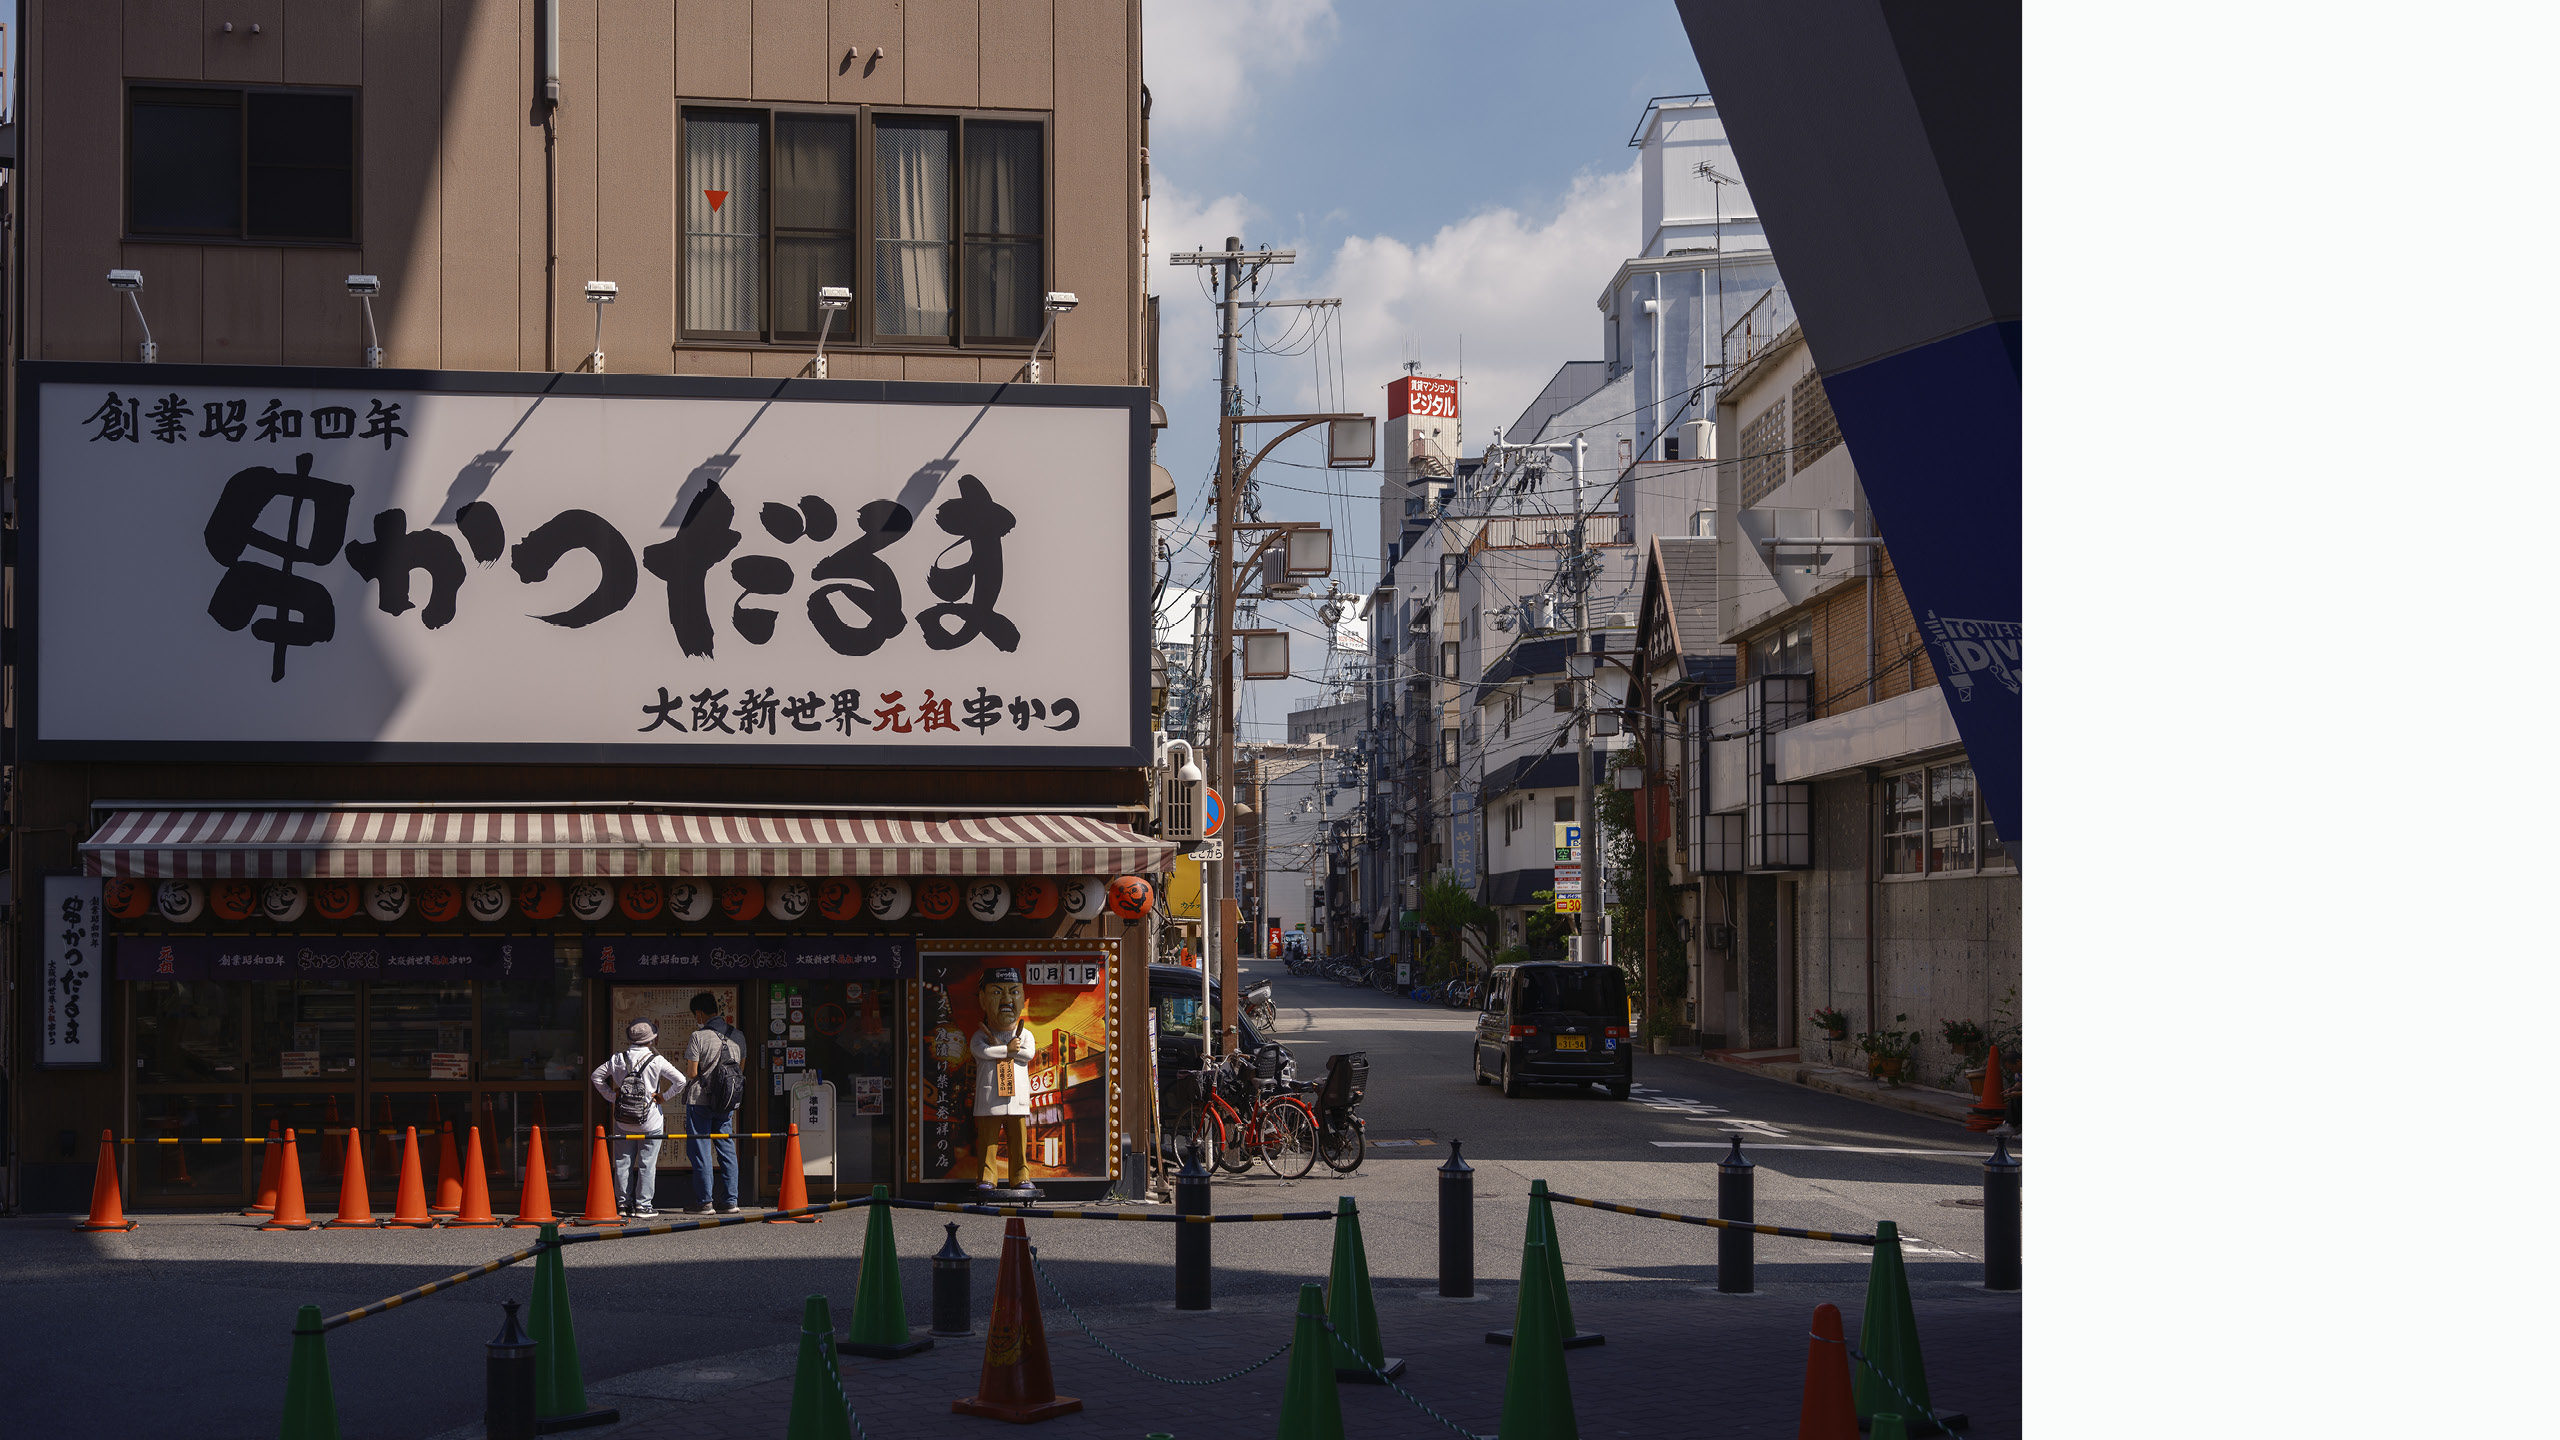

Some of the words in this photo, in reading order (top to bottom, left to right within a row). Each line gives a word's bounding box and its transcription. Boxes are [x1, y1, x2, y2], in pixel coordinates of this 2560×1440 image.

[1410, 393, 1456, 416] ビジタル
[82, 391, 409, 450] 創業昭和四年
[204, 452, 1020, 683] 串かつだるま
[638, 686, 1081, 738] 大阪新世界元祖串かつ
[90, 895, 100, 948] 創業昭和四年
[60, 895, 89, 1045] 串かつだるま
[156, 945, 175, 974] 元祖
[218, 954, 286, 967] 創業昭和四年
[298, 947, 380, 970] 串かつだるま
[387, 954, 472, 967] 大阪新世界元祖串かつ
[600, 945, 616, 974] 元祖
[637, 954, 700, 967] 創業昭和四年
[710, 947, 788, 970] 串かつだるま
[796, 953, 877, 966] 大阪新世界元祖串かつ
[935, 966, 950, 1168] ソース二度漬け禁止発祥の店
[808, 1095, 819, 1125] 準備中
